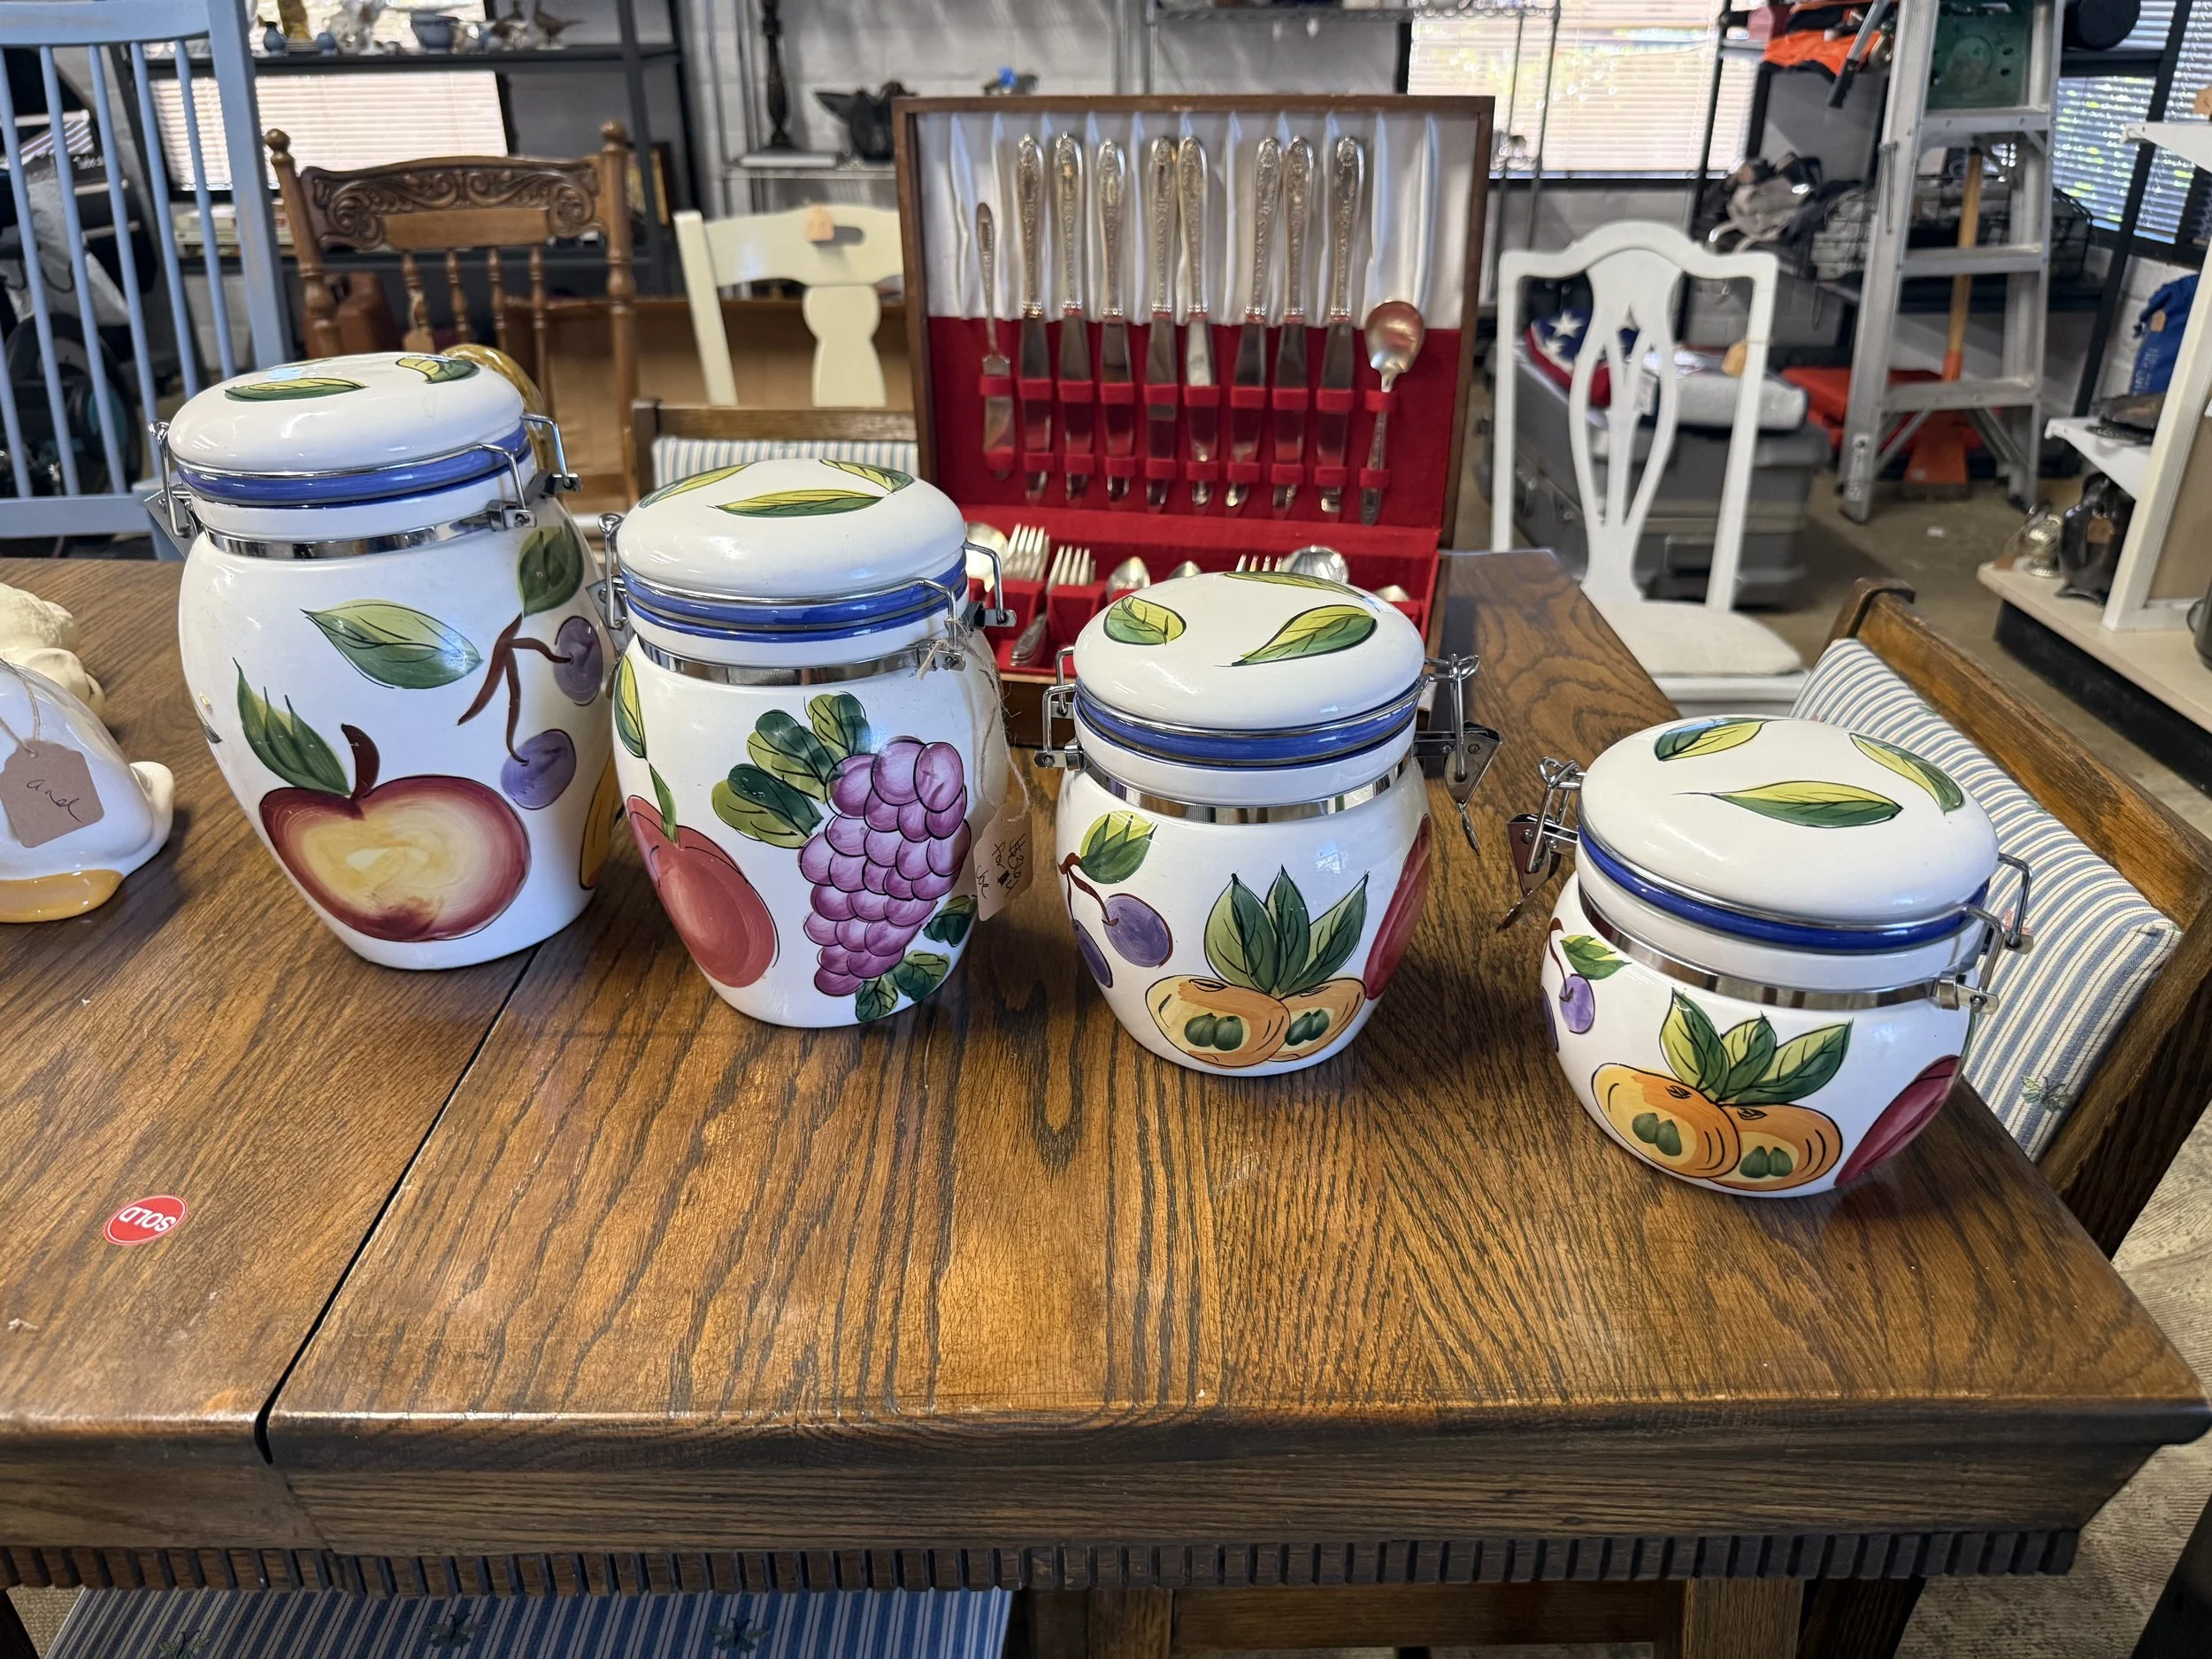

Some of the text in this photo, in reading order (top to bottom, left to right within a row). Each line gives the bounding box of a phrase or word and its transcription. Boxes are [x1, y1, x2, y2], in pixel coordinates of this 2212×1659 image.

[992, 841, 1006, 869] for
[975, 864, 989, 899] Joe
[119, 1206, 177, 1232] SOLD
